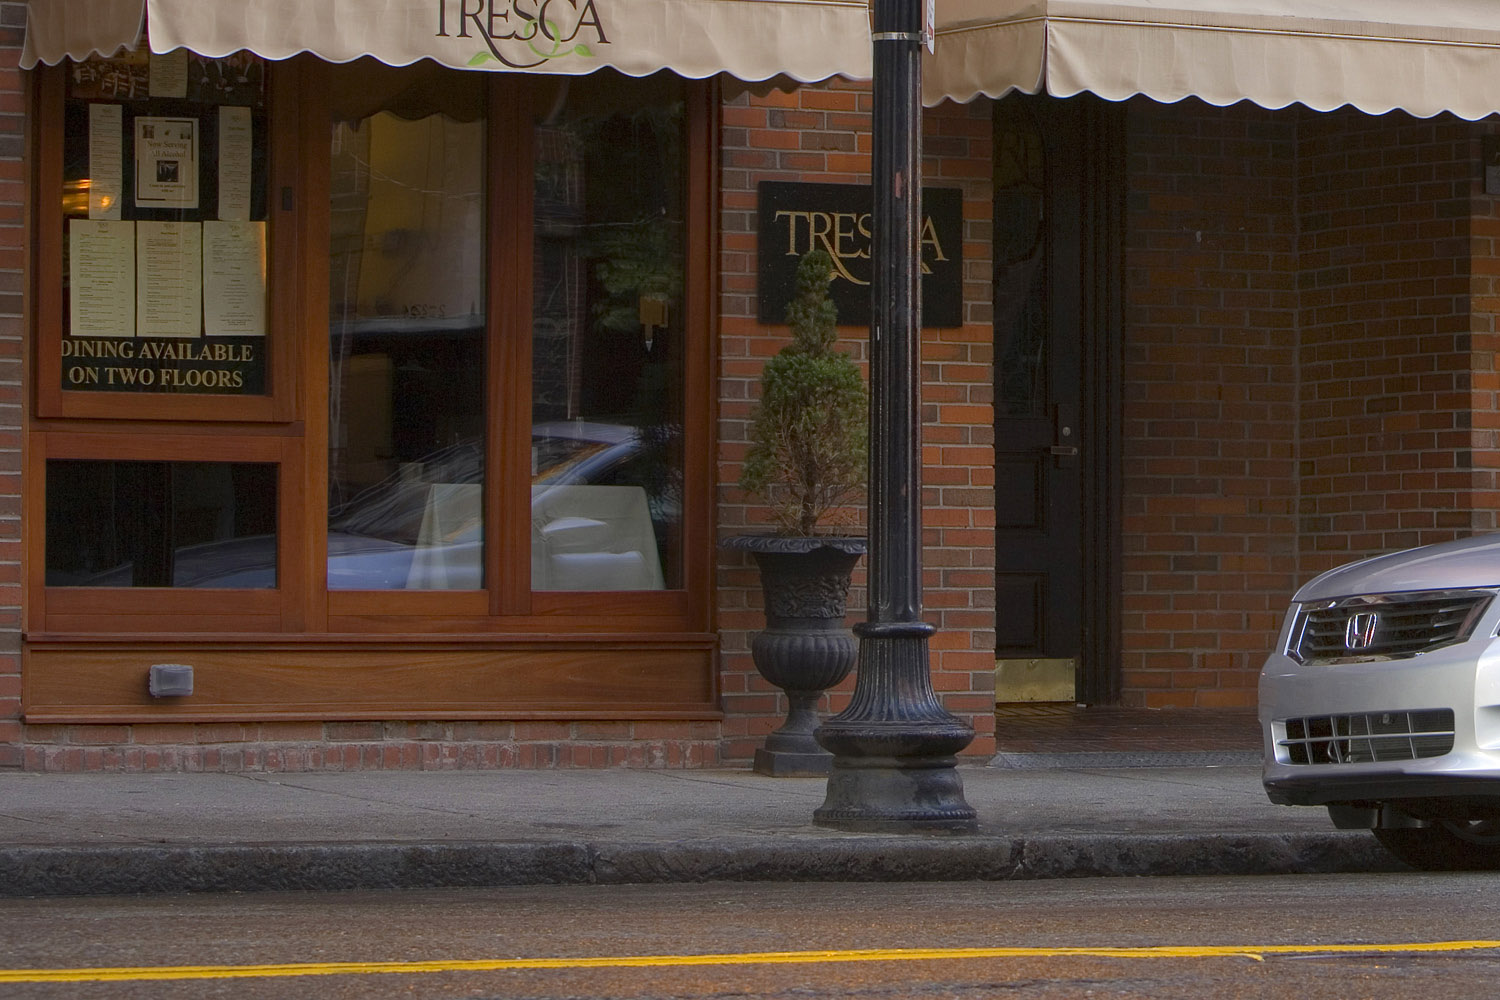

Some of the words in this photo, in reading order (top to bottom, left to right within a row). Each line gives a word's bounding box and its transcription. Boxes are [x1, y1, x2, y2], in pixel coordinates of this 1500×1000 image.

[775, 210, 950, 286] TRESA
[61, 339, 135, 359] DINING
[138, 341, 255, 362] AVAILABLE
[68, 366, 99, 385] ON
[104, 367, 156, 386] TWO
[159, 368, 244, 388] FLOORS
